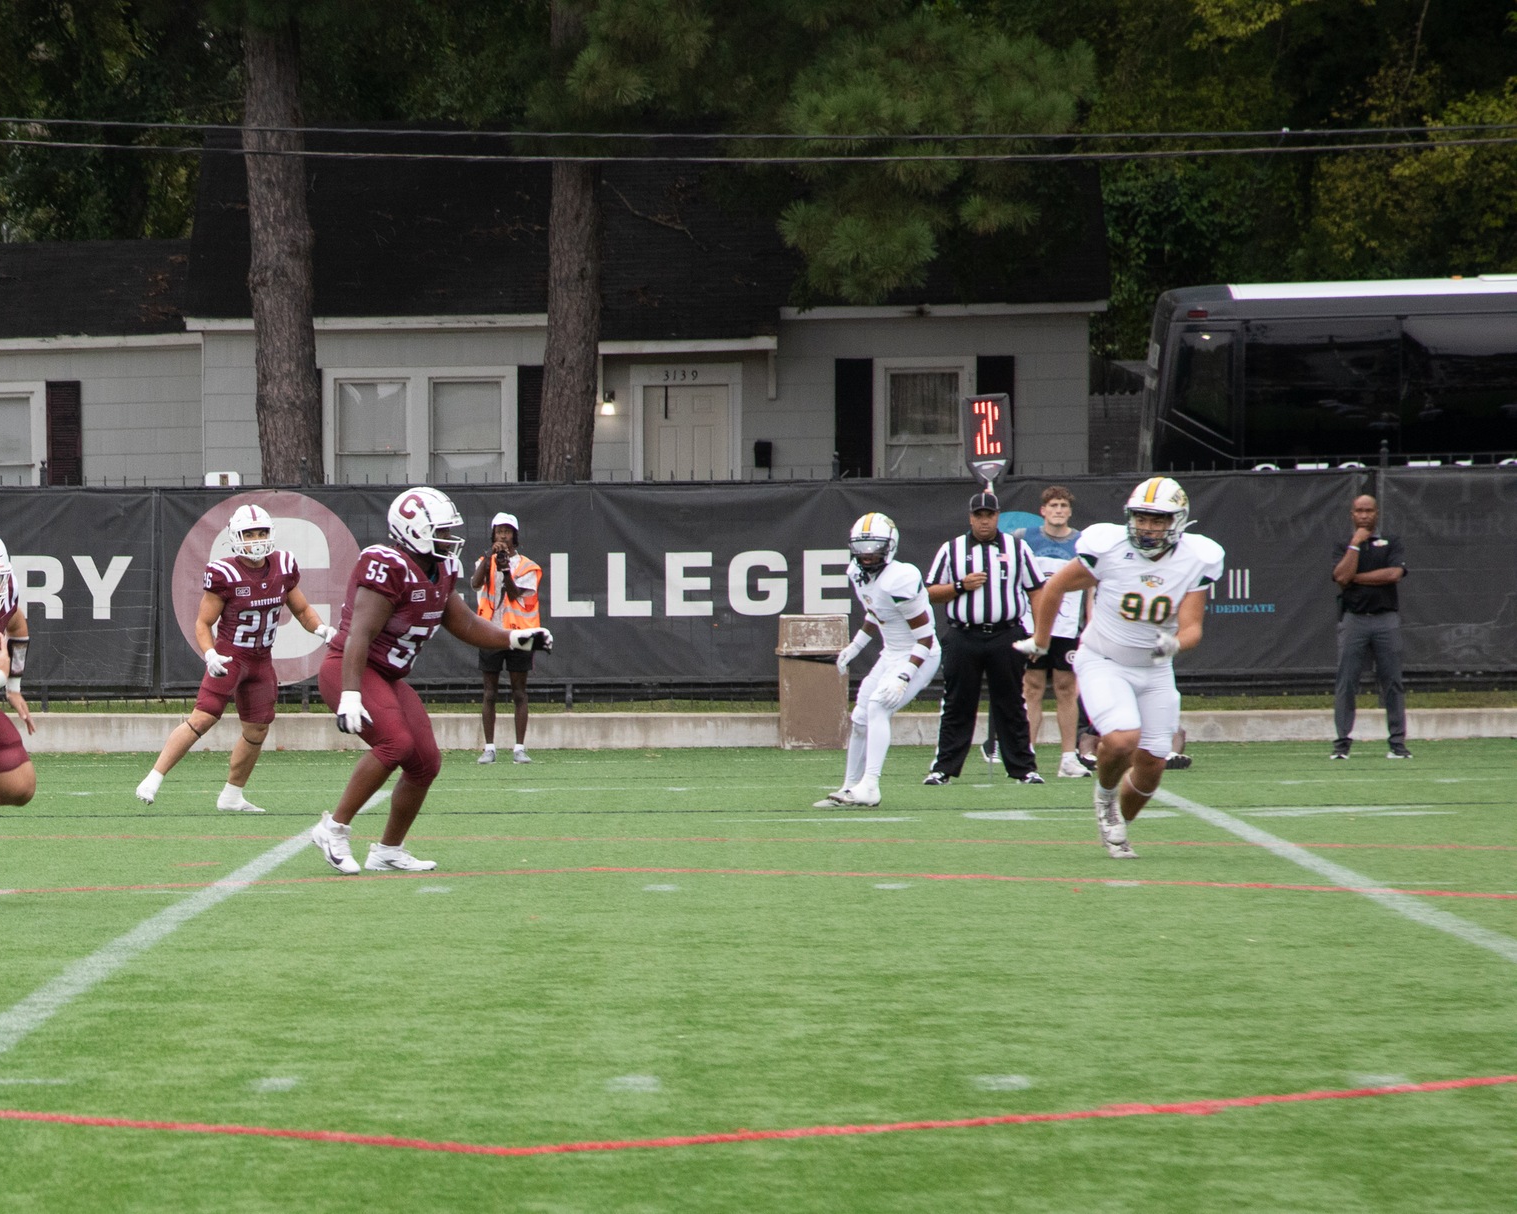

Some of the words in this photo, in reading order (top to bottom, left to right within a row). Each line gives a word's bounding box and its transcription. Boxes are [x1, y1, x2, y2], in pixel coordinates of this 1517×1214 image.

[663, 370, 699, 381] 3139
[973, 400, 1001, 455] 2
[399, 494, 424, 520] C
[365, 560, 390, 584] 55
[456, 549, 852, 617] LLEGE
[1000, 569, 1008, 580] L
[209, 517, 331, 660] C
[250, 596, 282, 607] SHREVEPORT
[1120, 591, 1172, 625] 90
[1215, 603, 1276, 614] DEDICATE
[233, 605, 282, 648] 26
